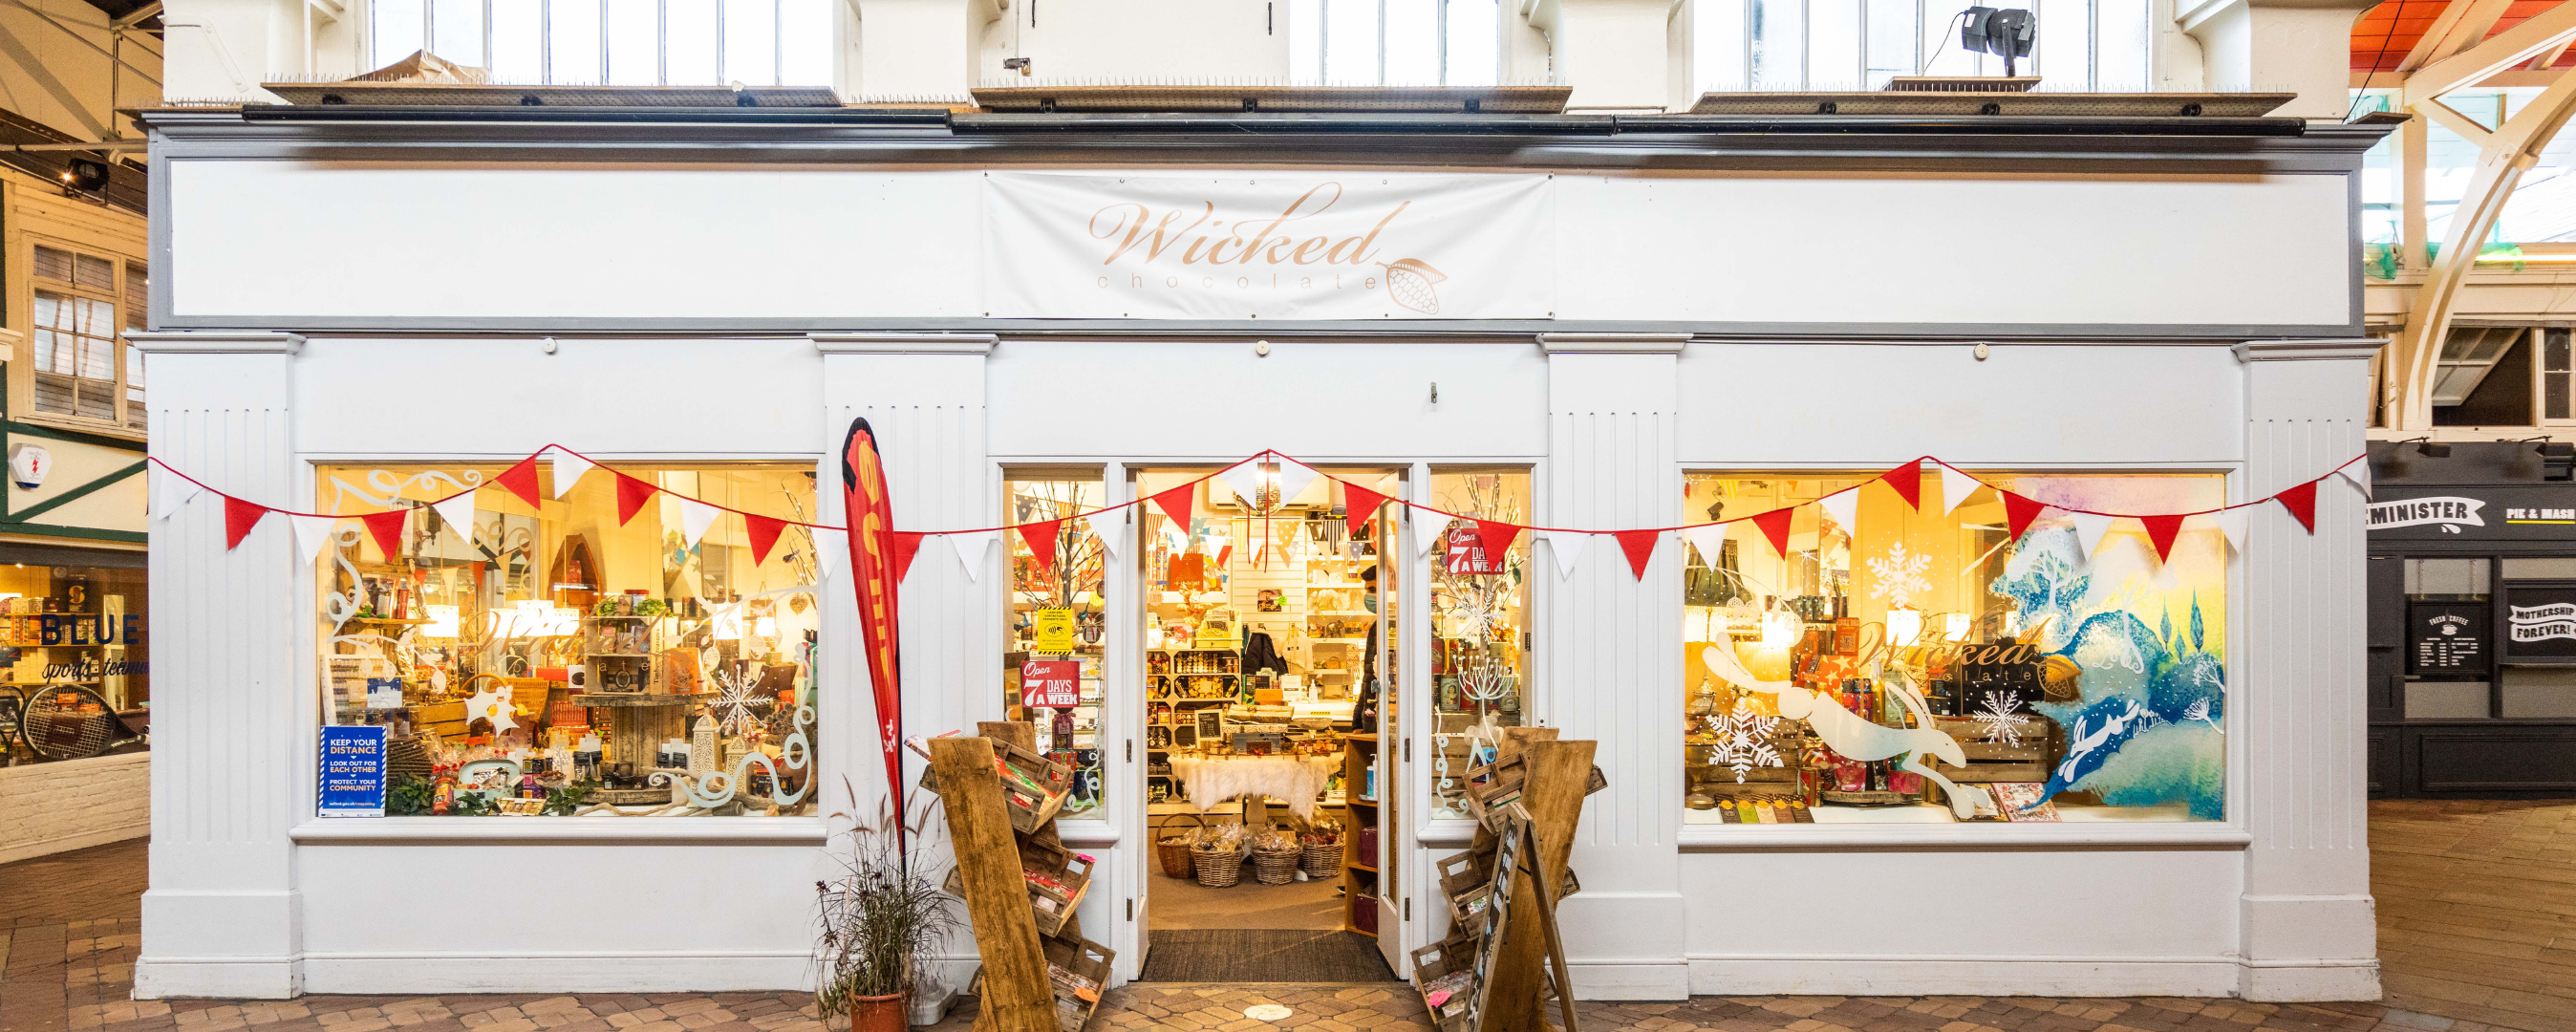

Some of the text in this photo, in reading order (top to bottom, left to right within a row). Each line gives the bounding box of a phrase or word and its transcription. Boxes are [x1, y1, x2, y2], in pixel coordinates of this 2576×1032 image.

[1089, 182, 1411, 265] Wicked
[1097, 272, 1376, 290] chocolate
[2366, 502, 2468, 525] MINISTER
[2506, 508, 2576, 519] PIE & MASH
[1449, 528, 1476, 545] Open
[1449, 545, 1489, 573] 7 DA
[1461, 561, 1503, 571] A WEK
[2429, 614, 2469, 626] FRESH COFFEE
[2516, 607, 2575, 619] MOTHERSHIP
[41, 613, 140, 645] BLUE
[463, 593, 671, 657] Wicked
[2517, 625, 2570, 638] FOREVER!
[1854, 603, 2052, 668] Wicked
[42, 657, 91, 684] sports
[1023, 661, 1051, 677] Open
[1023, 677, 1072, 706] 7 DAYS
[1036, 694, 1078, 705] A WEEK
